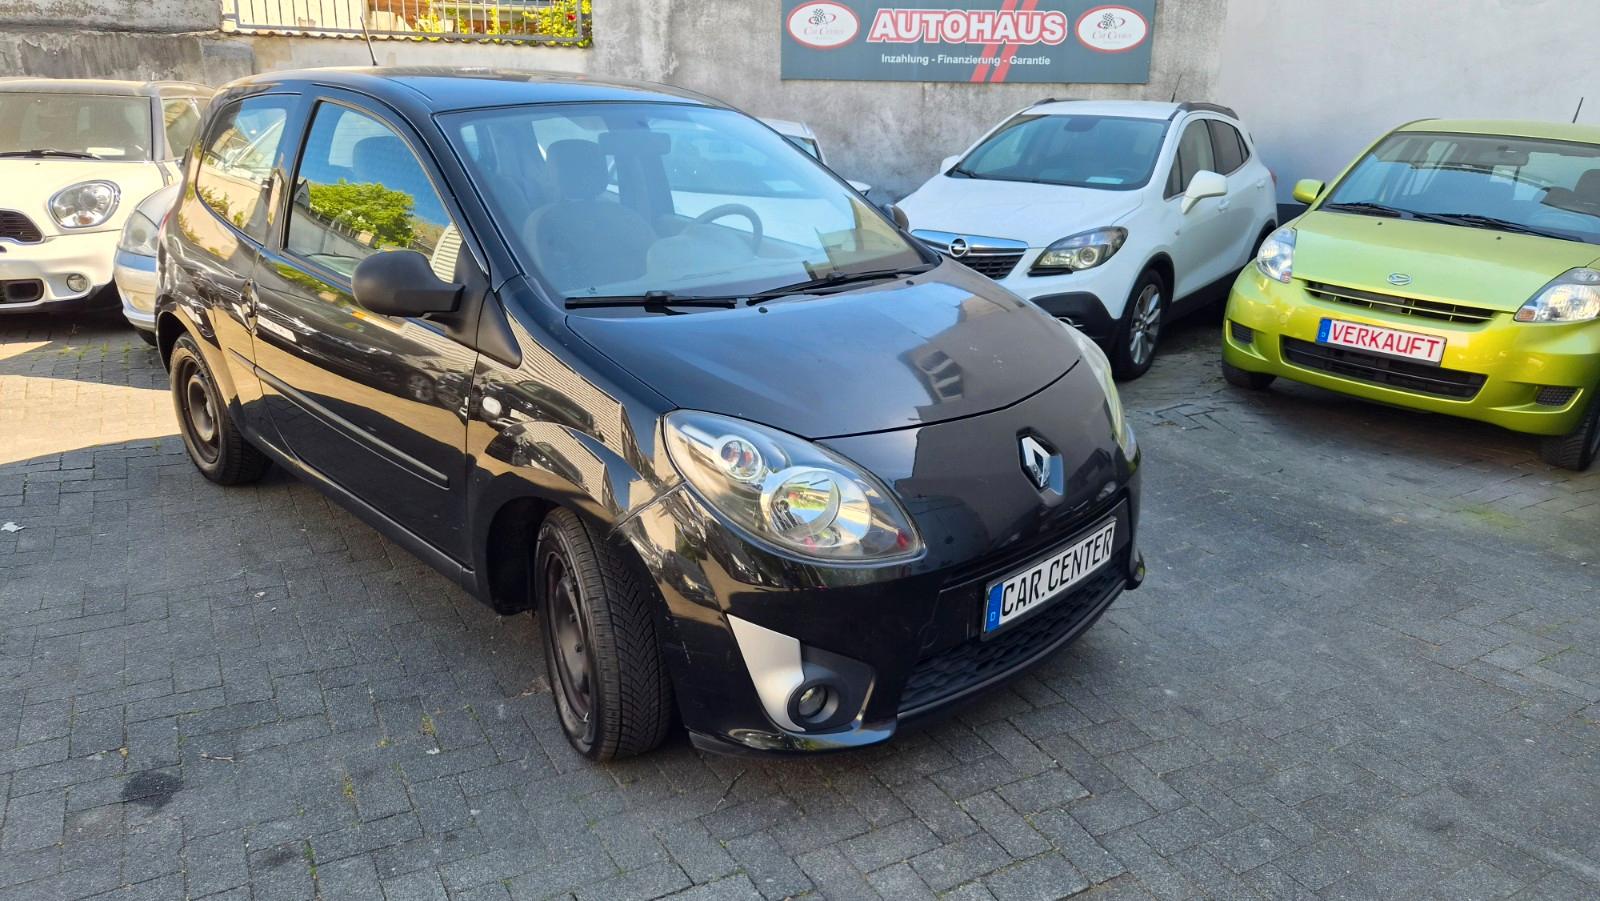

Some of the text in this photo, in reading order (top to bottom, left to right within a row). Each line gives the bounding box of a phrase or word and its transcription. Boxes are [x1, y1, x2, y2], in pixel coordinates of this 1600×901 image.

[866, 8, 1067, 45] AUTOHAUS
[881, 53, 929, 66] Inzahlung
[937, 54, 1001, 67] Finanzierung
[1009, 55, 1051, 65] Garantie
[1332, 323, 1440, 358] VERKAUFT
[1001, 526, 1113, 617] CAR.CENTER
